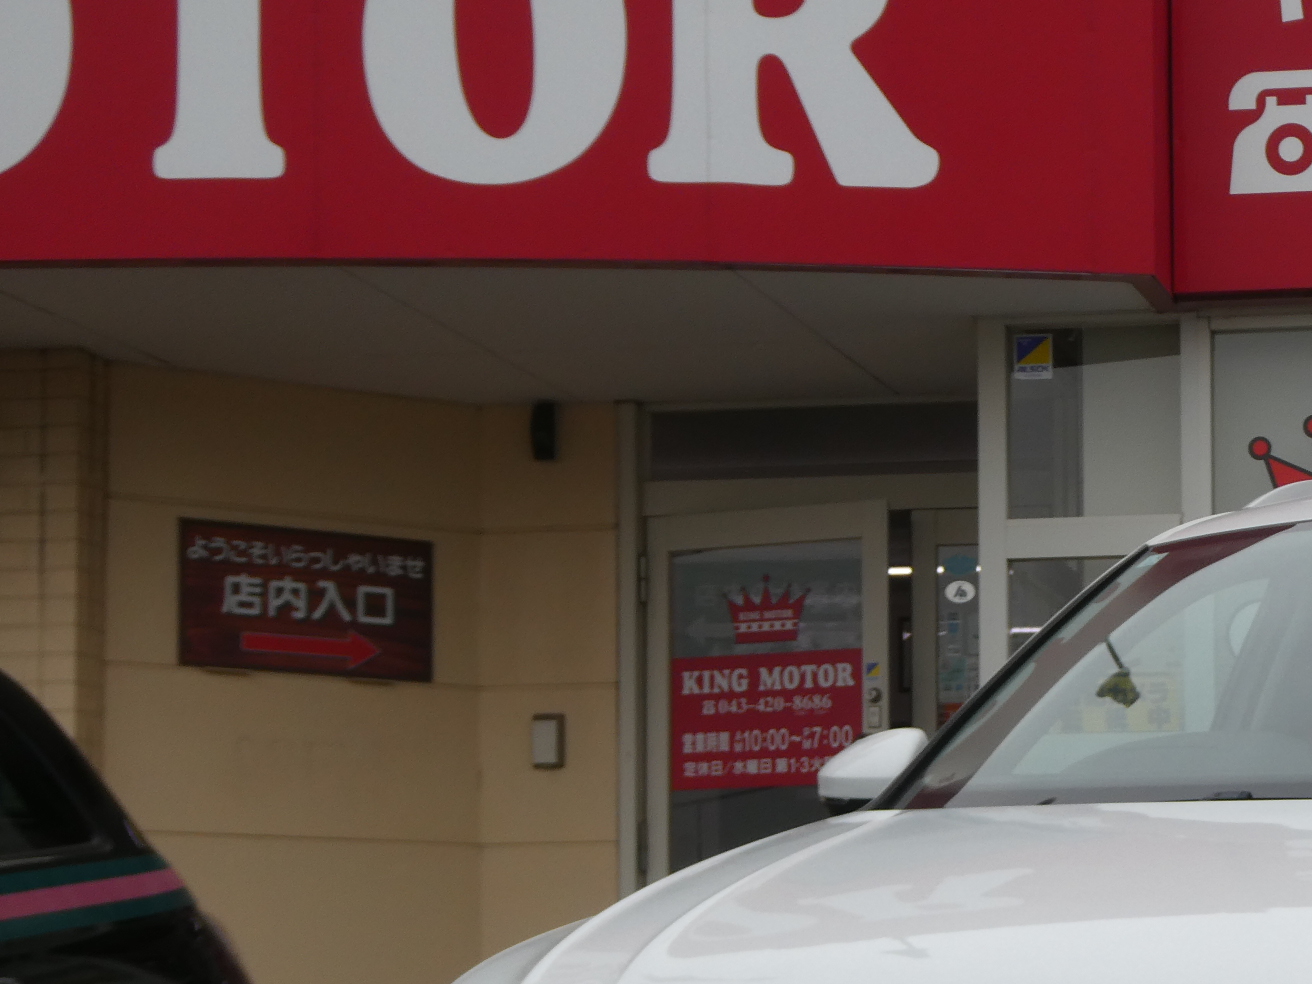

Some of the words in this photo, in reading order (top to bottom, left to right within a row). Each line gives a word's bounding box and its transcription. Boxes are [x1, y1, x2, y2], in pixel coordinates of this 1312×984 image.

[0, 0, 940, 188] TOR
[186, 535, 427, 580] ようこそいらっしゃいませ
[220, 573, 396, 626] 店内入口
[681, 668, 750, 695] KING
[758, 662, 855, 692] MOTOR
